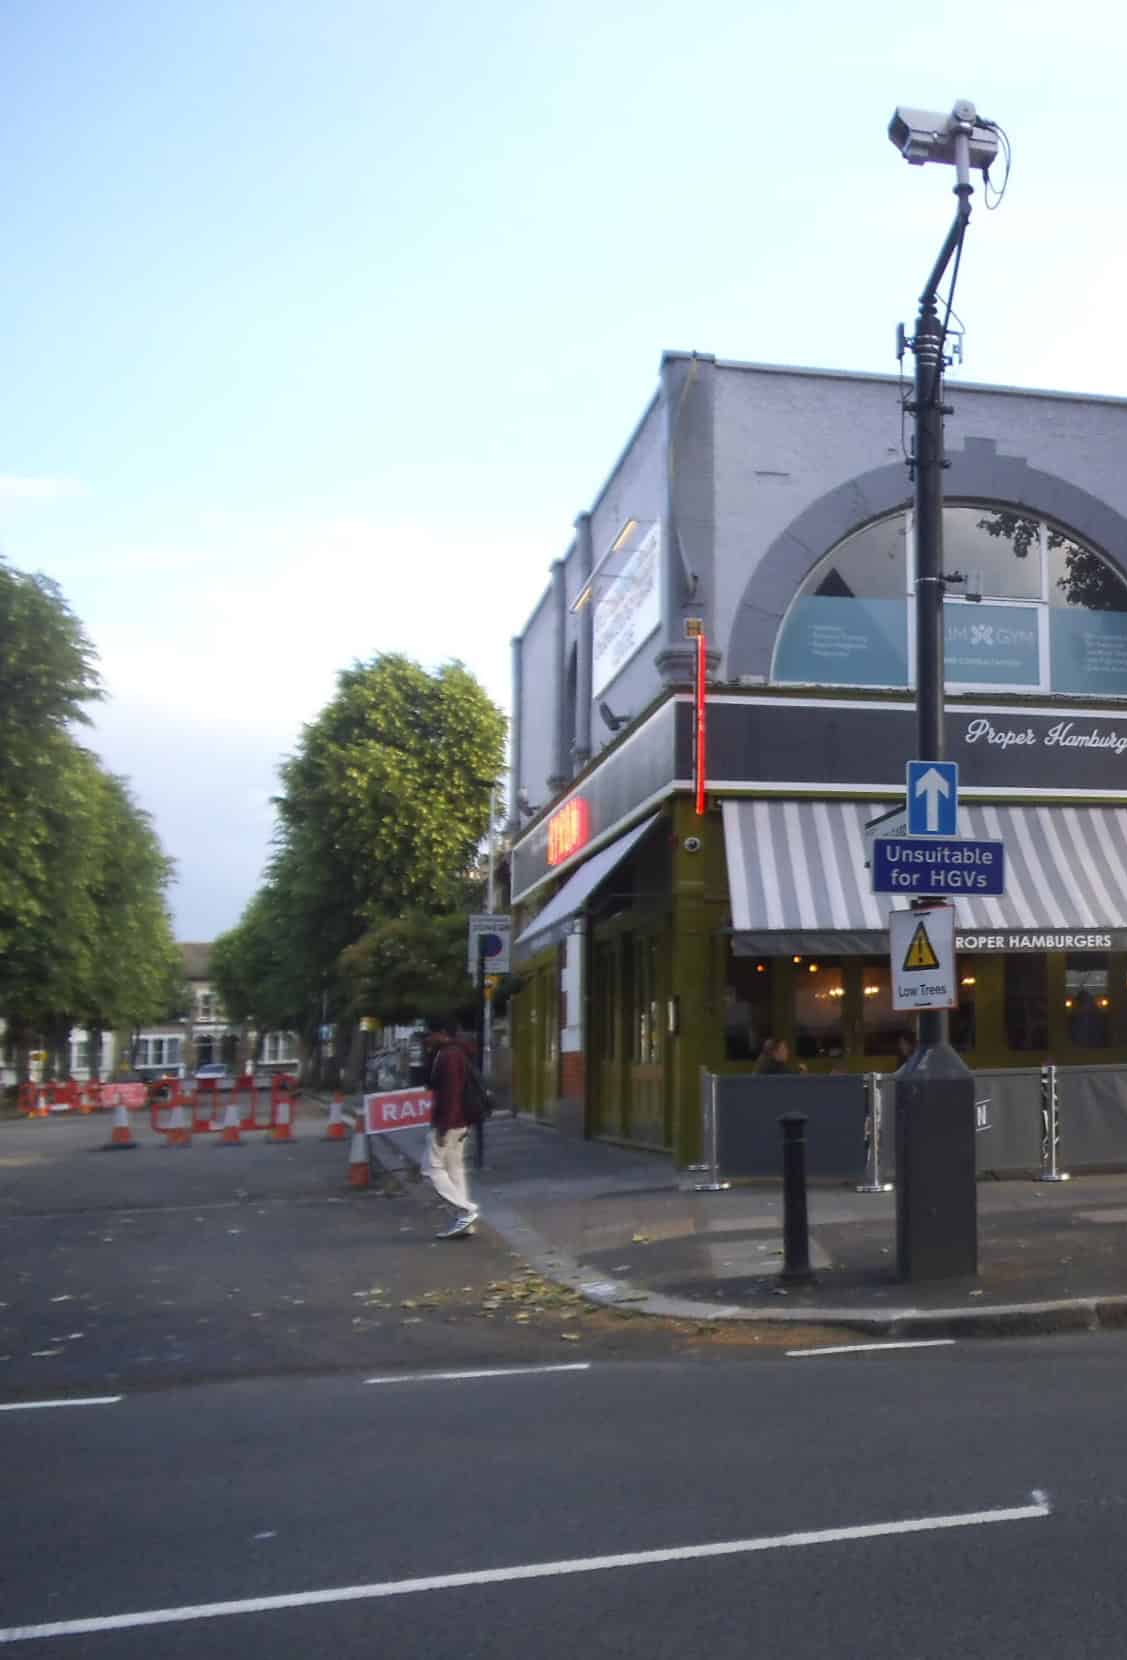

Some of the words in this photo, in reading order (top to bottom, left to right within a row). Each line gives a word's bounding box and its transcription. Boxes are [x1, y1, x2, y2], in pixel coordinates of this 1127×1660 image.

[965, 718, 1037, 745] Proper
[886, 845, 993, 864] Unsuitable
[891, 868, 920, 886] for
[930, 869, 988, 887] HGVs
[955, 936, 1005, 948] ROPER
[1009, 935, 1112, 948] HAMBURGERS
[898, 985, 917, 998] Low
[919, 984, 947, 995] Trees
